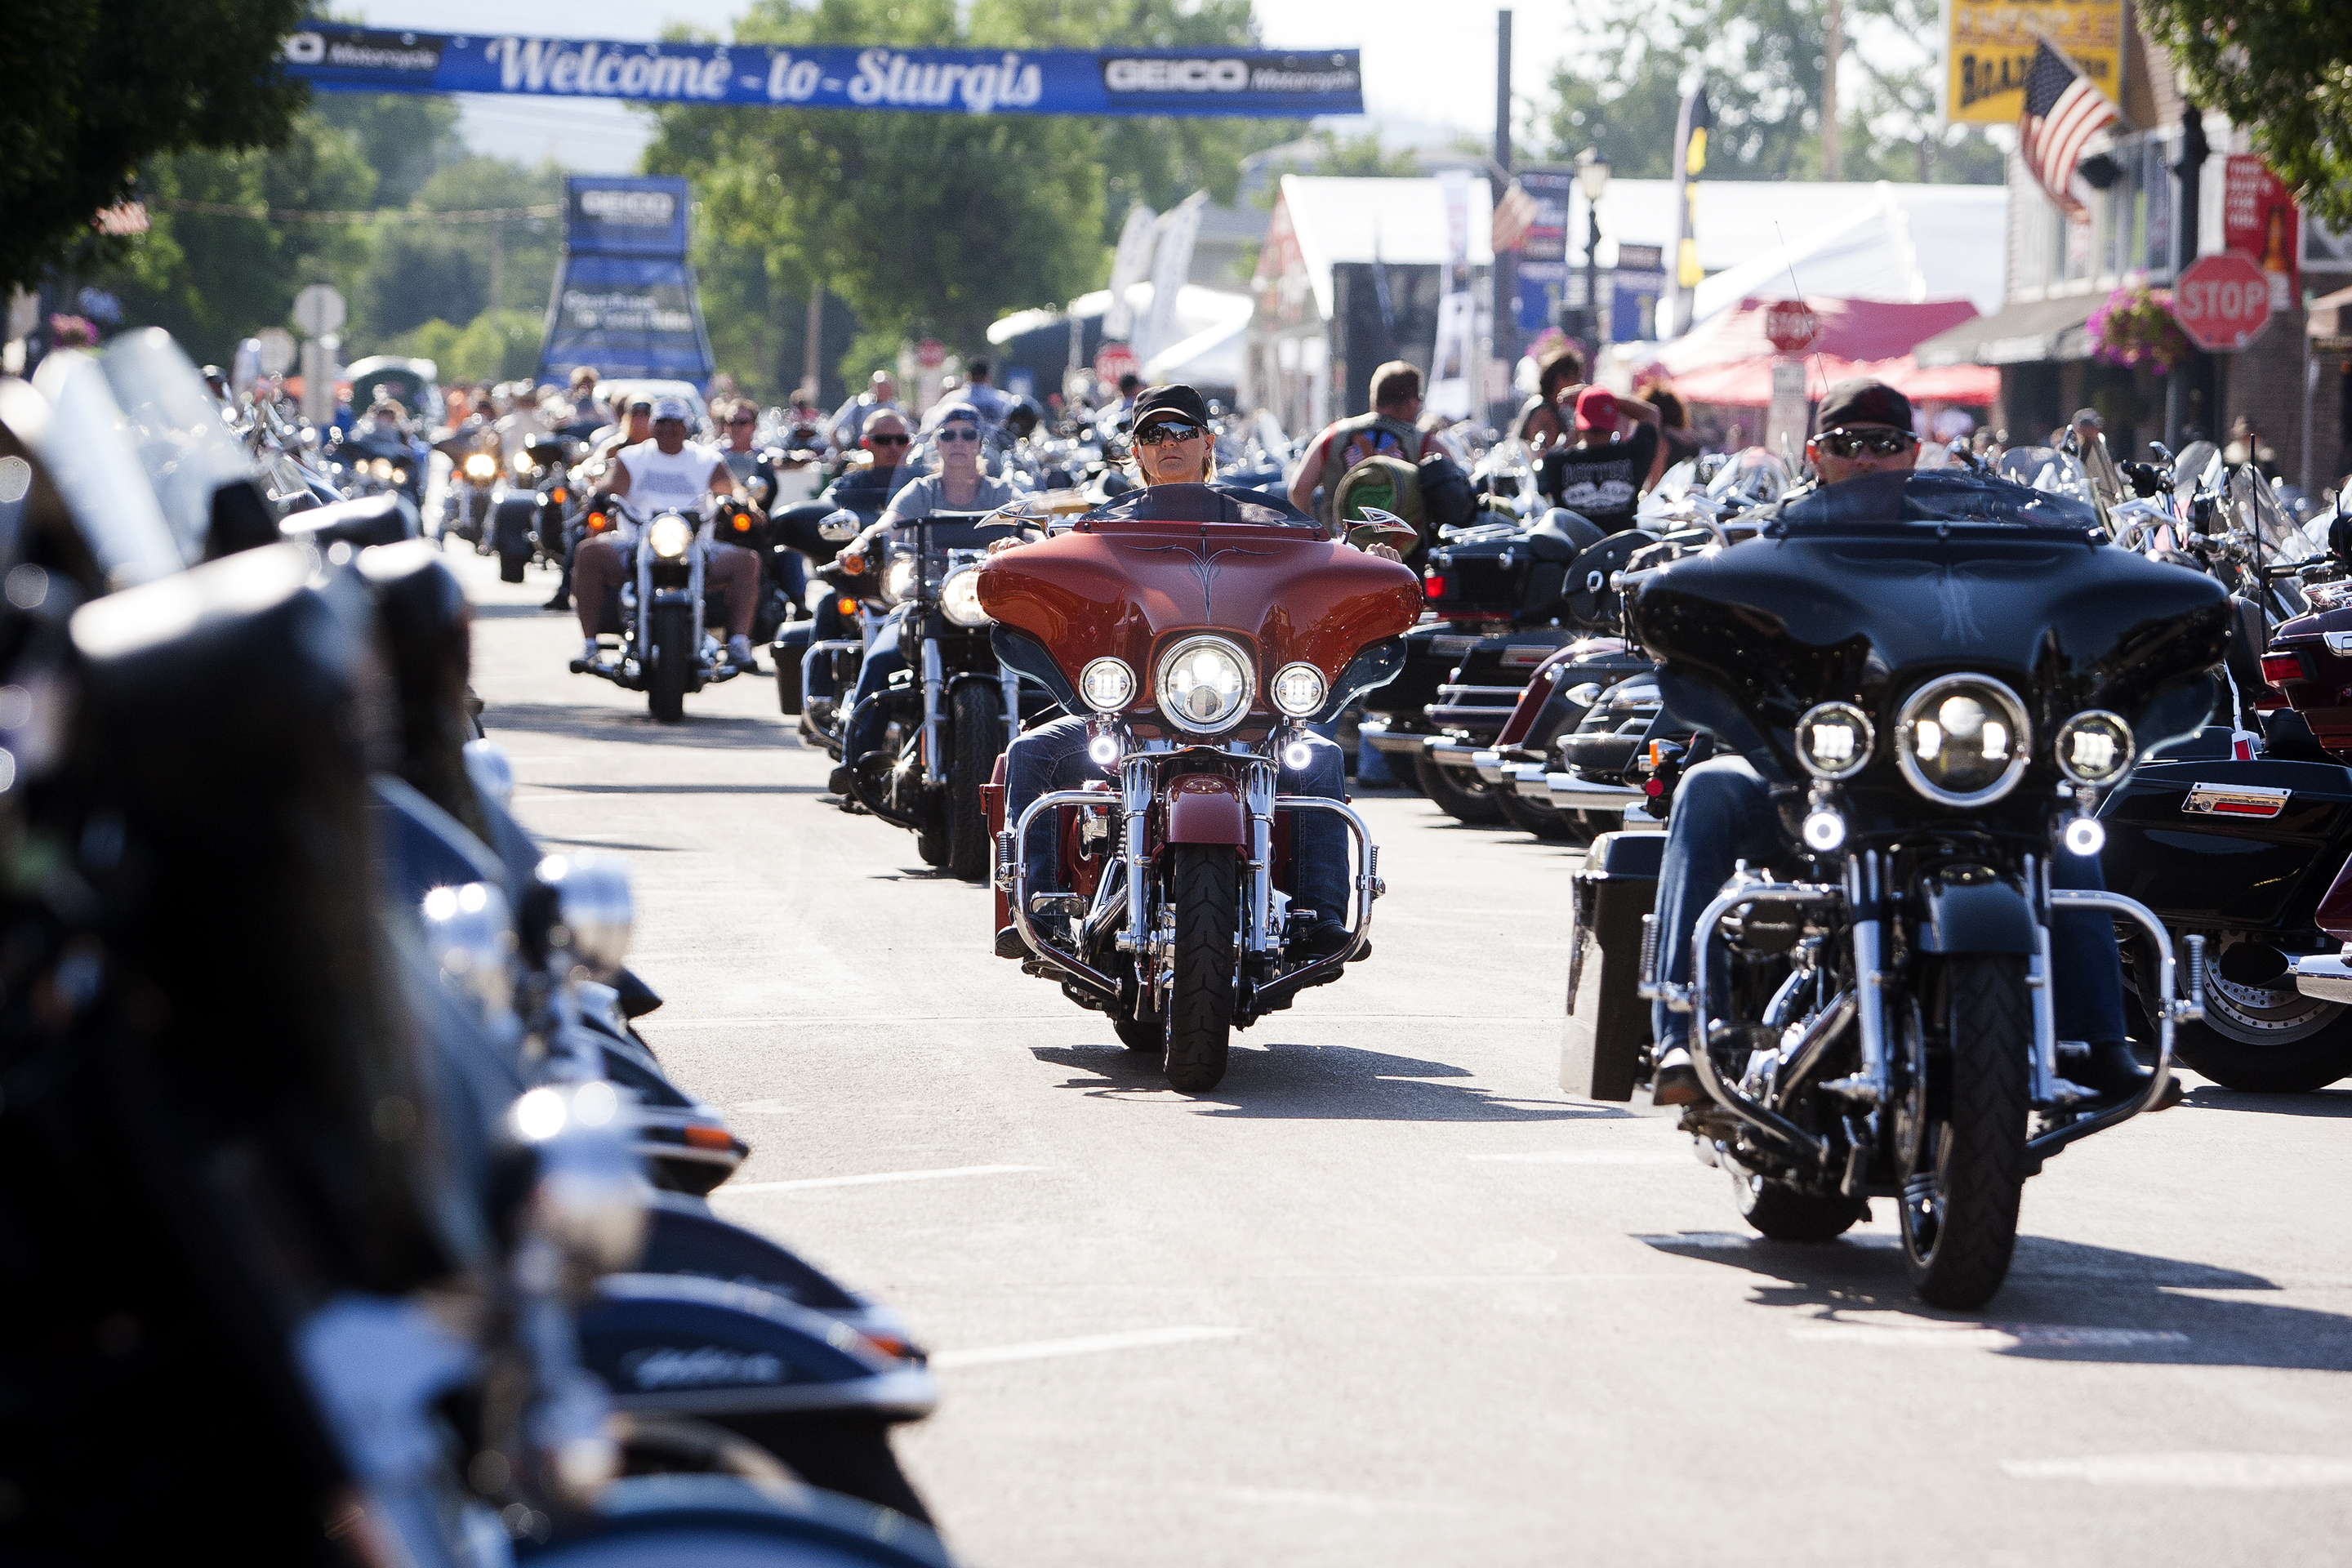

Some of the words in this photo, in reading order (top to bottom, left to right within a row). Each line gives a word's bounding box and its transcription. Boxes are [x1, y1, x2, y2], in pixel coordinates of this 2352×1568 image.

[484, 38, 733, 100] Welcome
[847, 48, 1042, 115] Sturgis
[1104, 58, 1250, 93] GEICO
[2181, 279, 2265, 321] STOP
[1766, 310, 1817, 339] STOP
